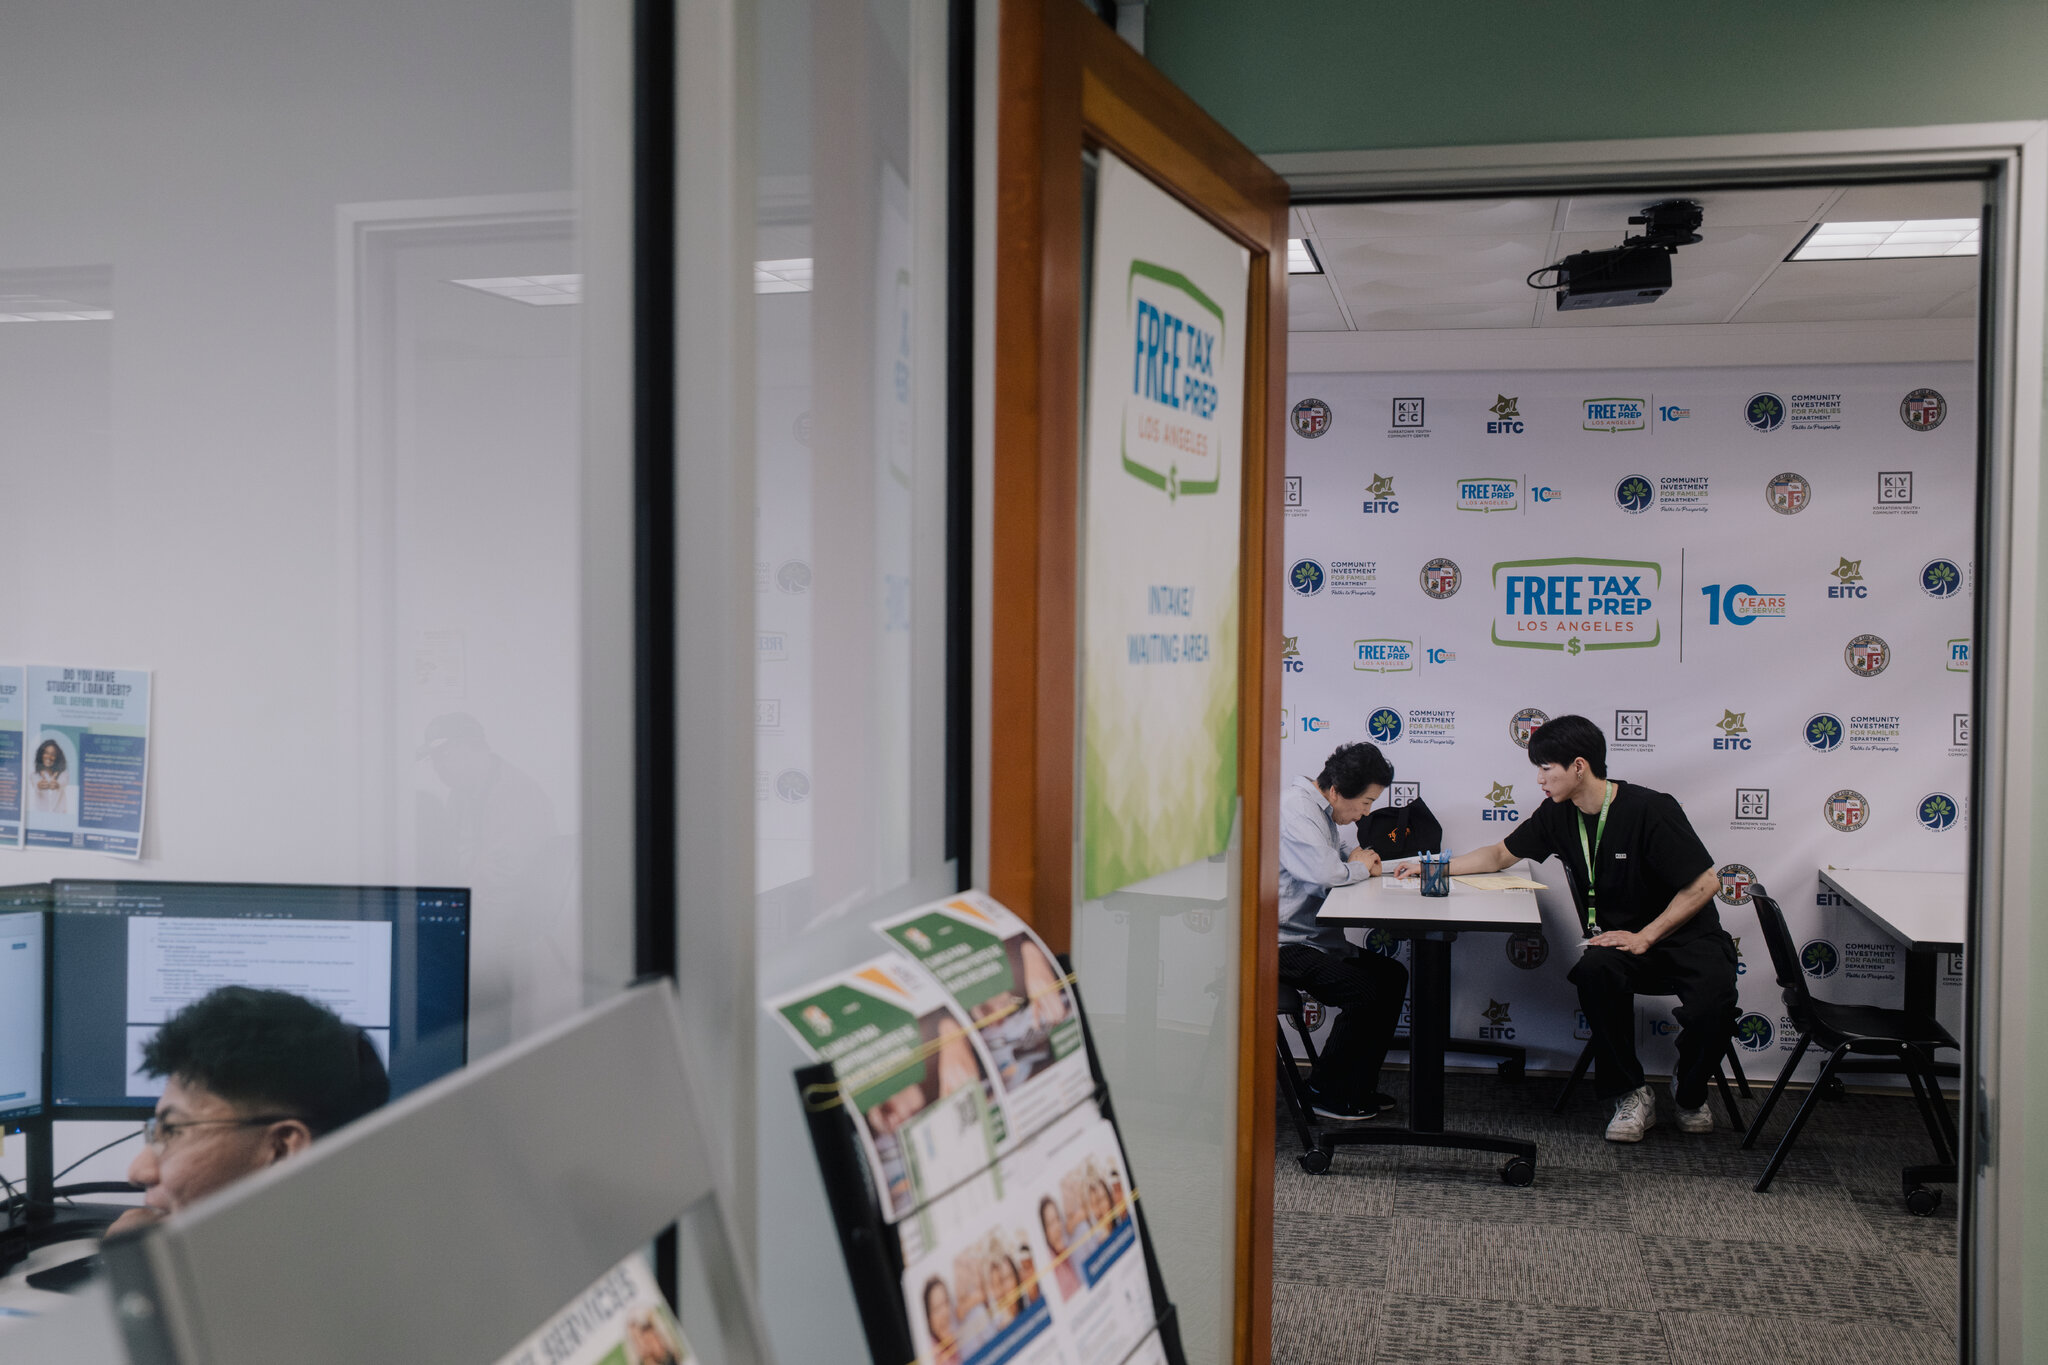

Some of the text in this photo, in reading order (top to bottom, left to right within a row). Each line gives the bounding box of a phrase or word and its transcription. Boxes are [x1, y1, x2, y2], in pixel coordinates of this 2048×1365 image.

[1133, 298, 1215, 409] FREE TAX
[1183, 374, 1219, 421] PREP
[1588, 404, 1638, 420] FREE TAX
[1136, 413, 1209, 457] LOS ANGELES
[1487, 421, 1524, 434] EITC
[1461, 484, 1511, 499] FREE TAX
[1363, 501, 1399, 514] EITC
[1506, 575, 1641, 615] FREE TAX
[1828, 586, 1867, 599] EITC
[1588, 598, 1652, 615] PREP
[1701, 584, 1758, 626] 10
[1738, 597, 1786, 607] YEARS
[1517, 620, 1634, 632] LOS ANGELES
[1126, 634, 1210, 665] WAITING AREA
[1358, 645, 1406, 660] FREE TAX
[1952, 644, 1968, 660] FR
[47, 680, 81, 694] STUDENT
[1713, 738, 1752, 751] EITC
[1491, 787, 1513, 803] Cal
[1482, 809, 1519, 821] EITC
[1479, 1026, 1516, 1040] EITC
